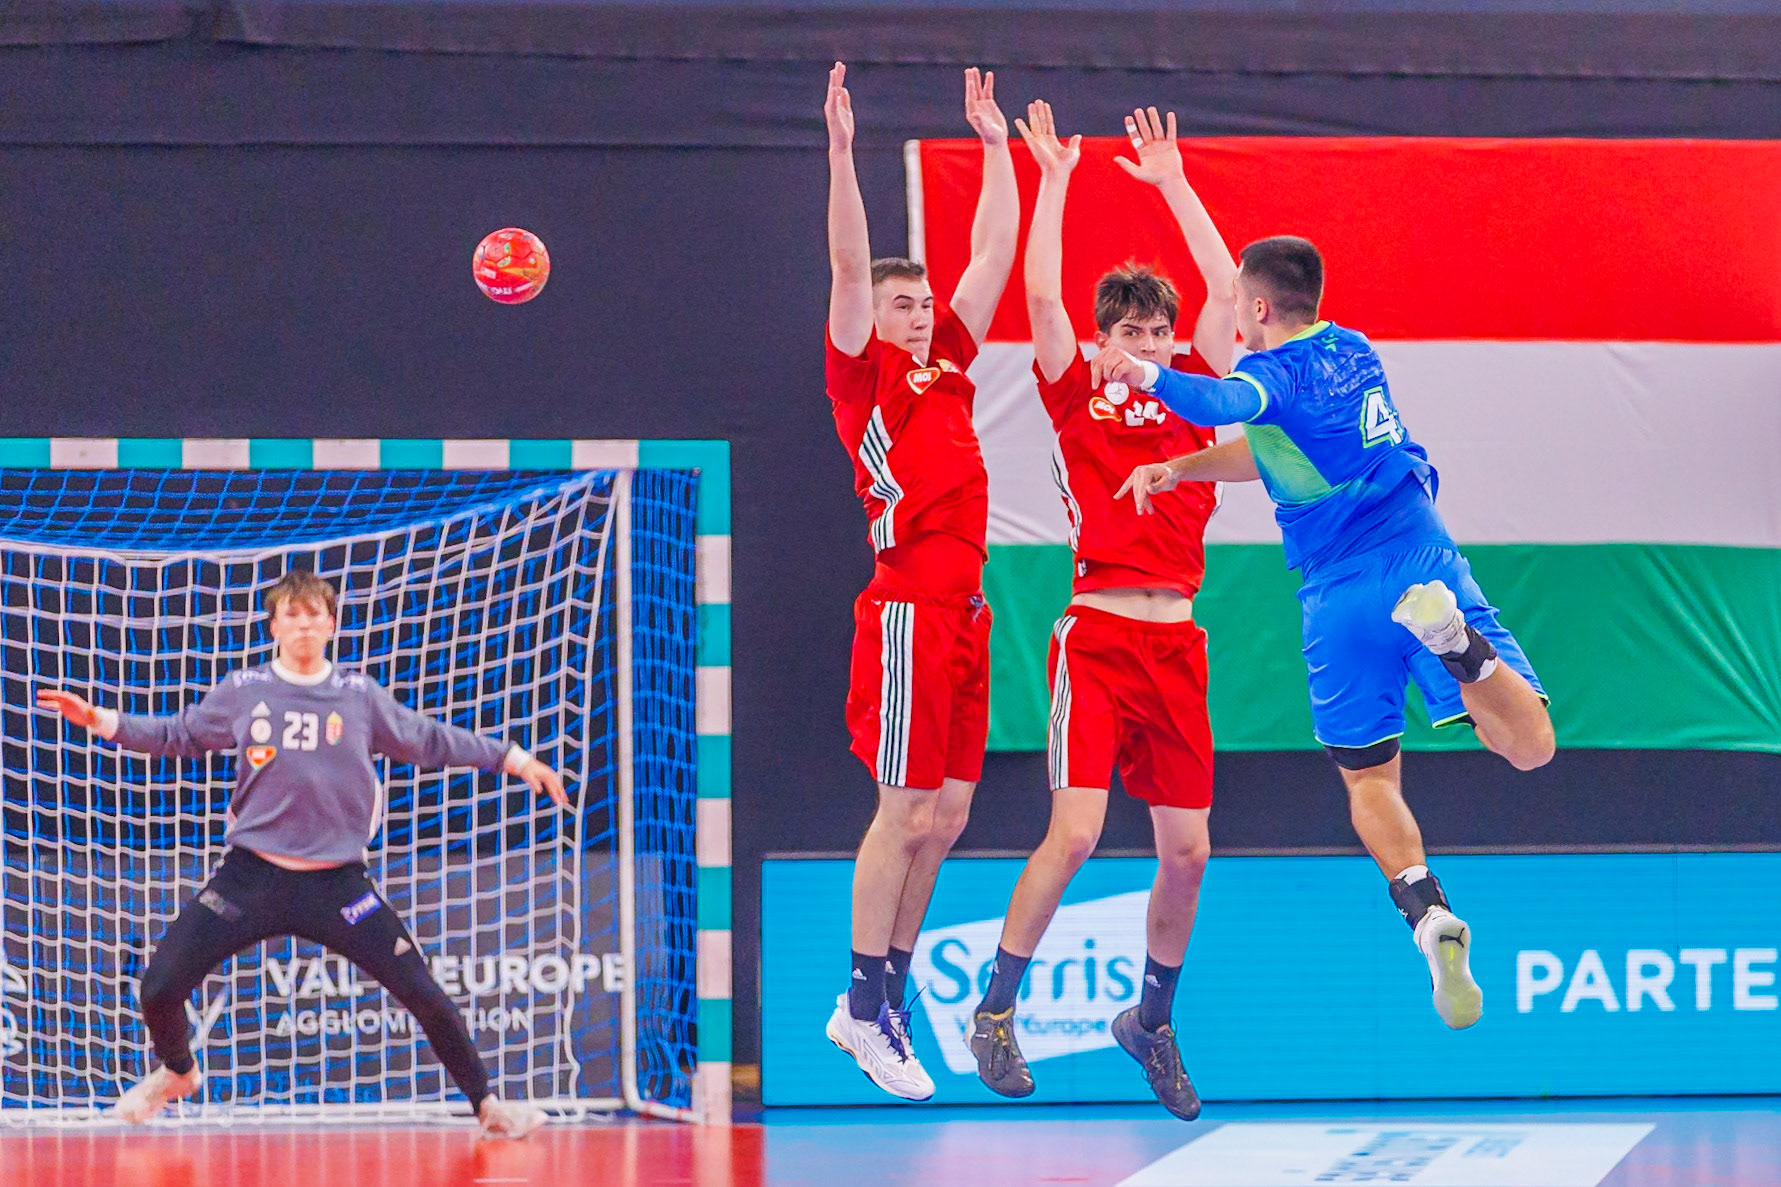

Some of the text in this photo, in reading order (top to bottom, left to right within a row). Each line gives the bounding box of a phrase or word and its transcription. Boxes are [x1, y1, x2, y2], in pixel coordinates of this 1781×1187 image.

[1359, 385, 1405, 448] 4
[282, 711, 319, 751] 23
[266, 956, 365, 997] VAL
[1516, 947, 1779, 1013] PARTE
[275, 1007, 532, 1036] AGGLOMTION
